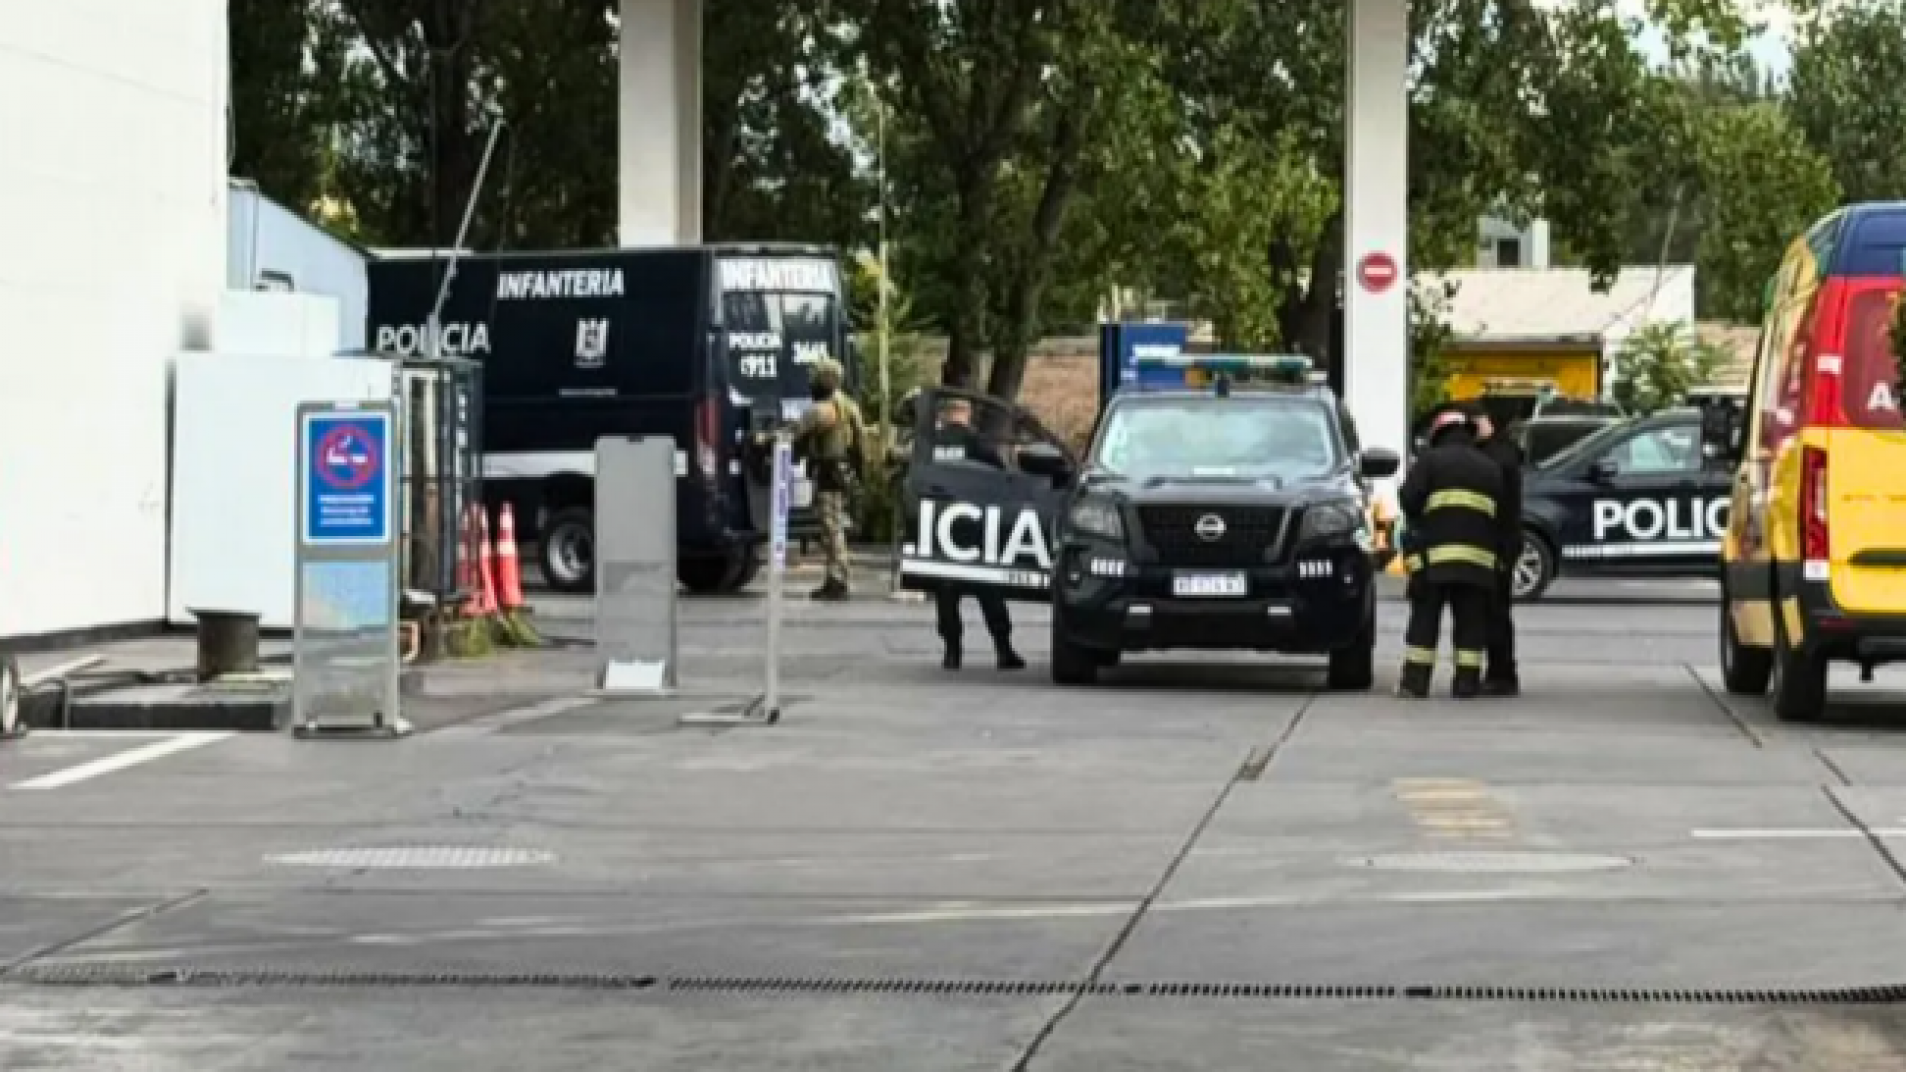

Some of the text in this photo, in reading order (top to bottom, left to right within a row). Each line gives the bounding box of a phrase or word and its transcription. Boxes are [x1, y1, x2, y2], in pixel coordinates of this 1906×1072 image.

[497, 268, 625, 299] INFANTERIA
[902, 498, 1051, 568] ICIA
[1592, 497, 1733, 540] POLIC
